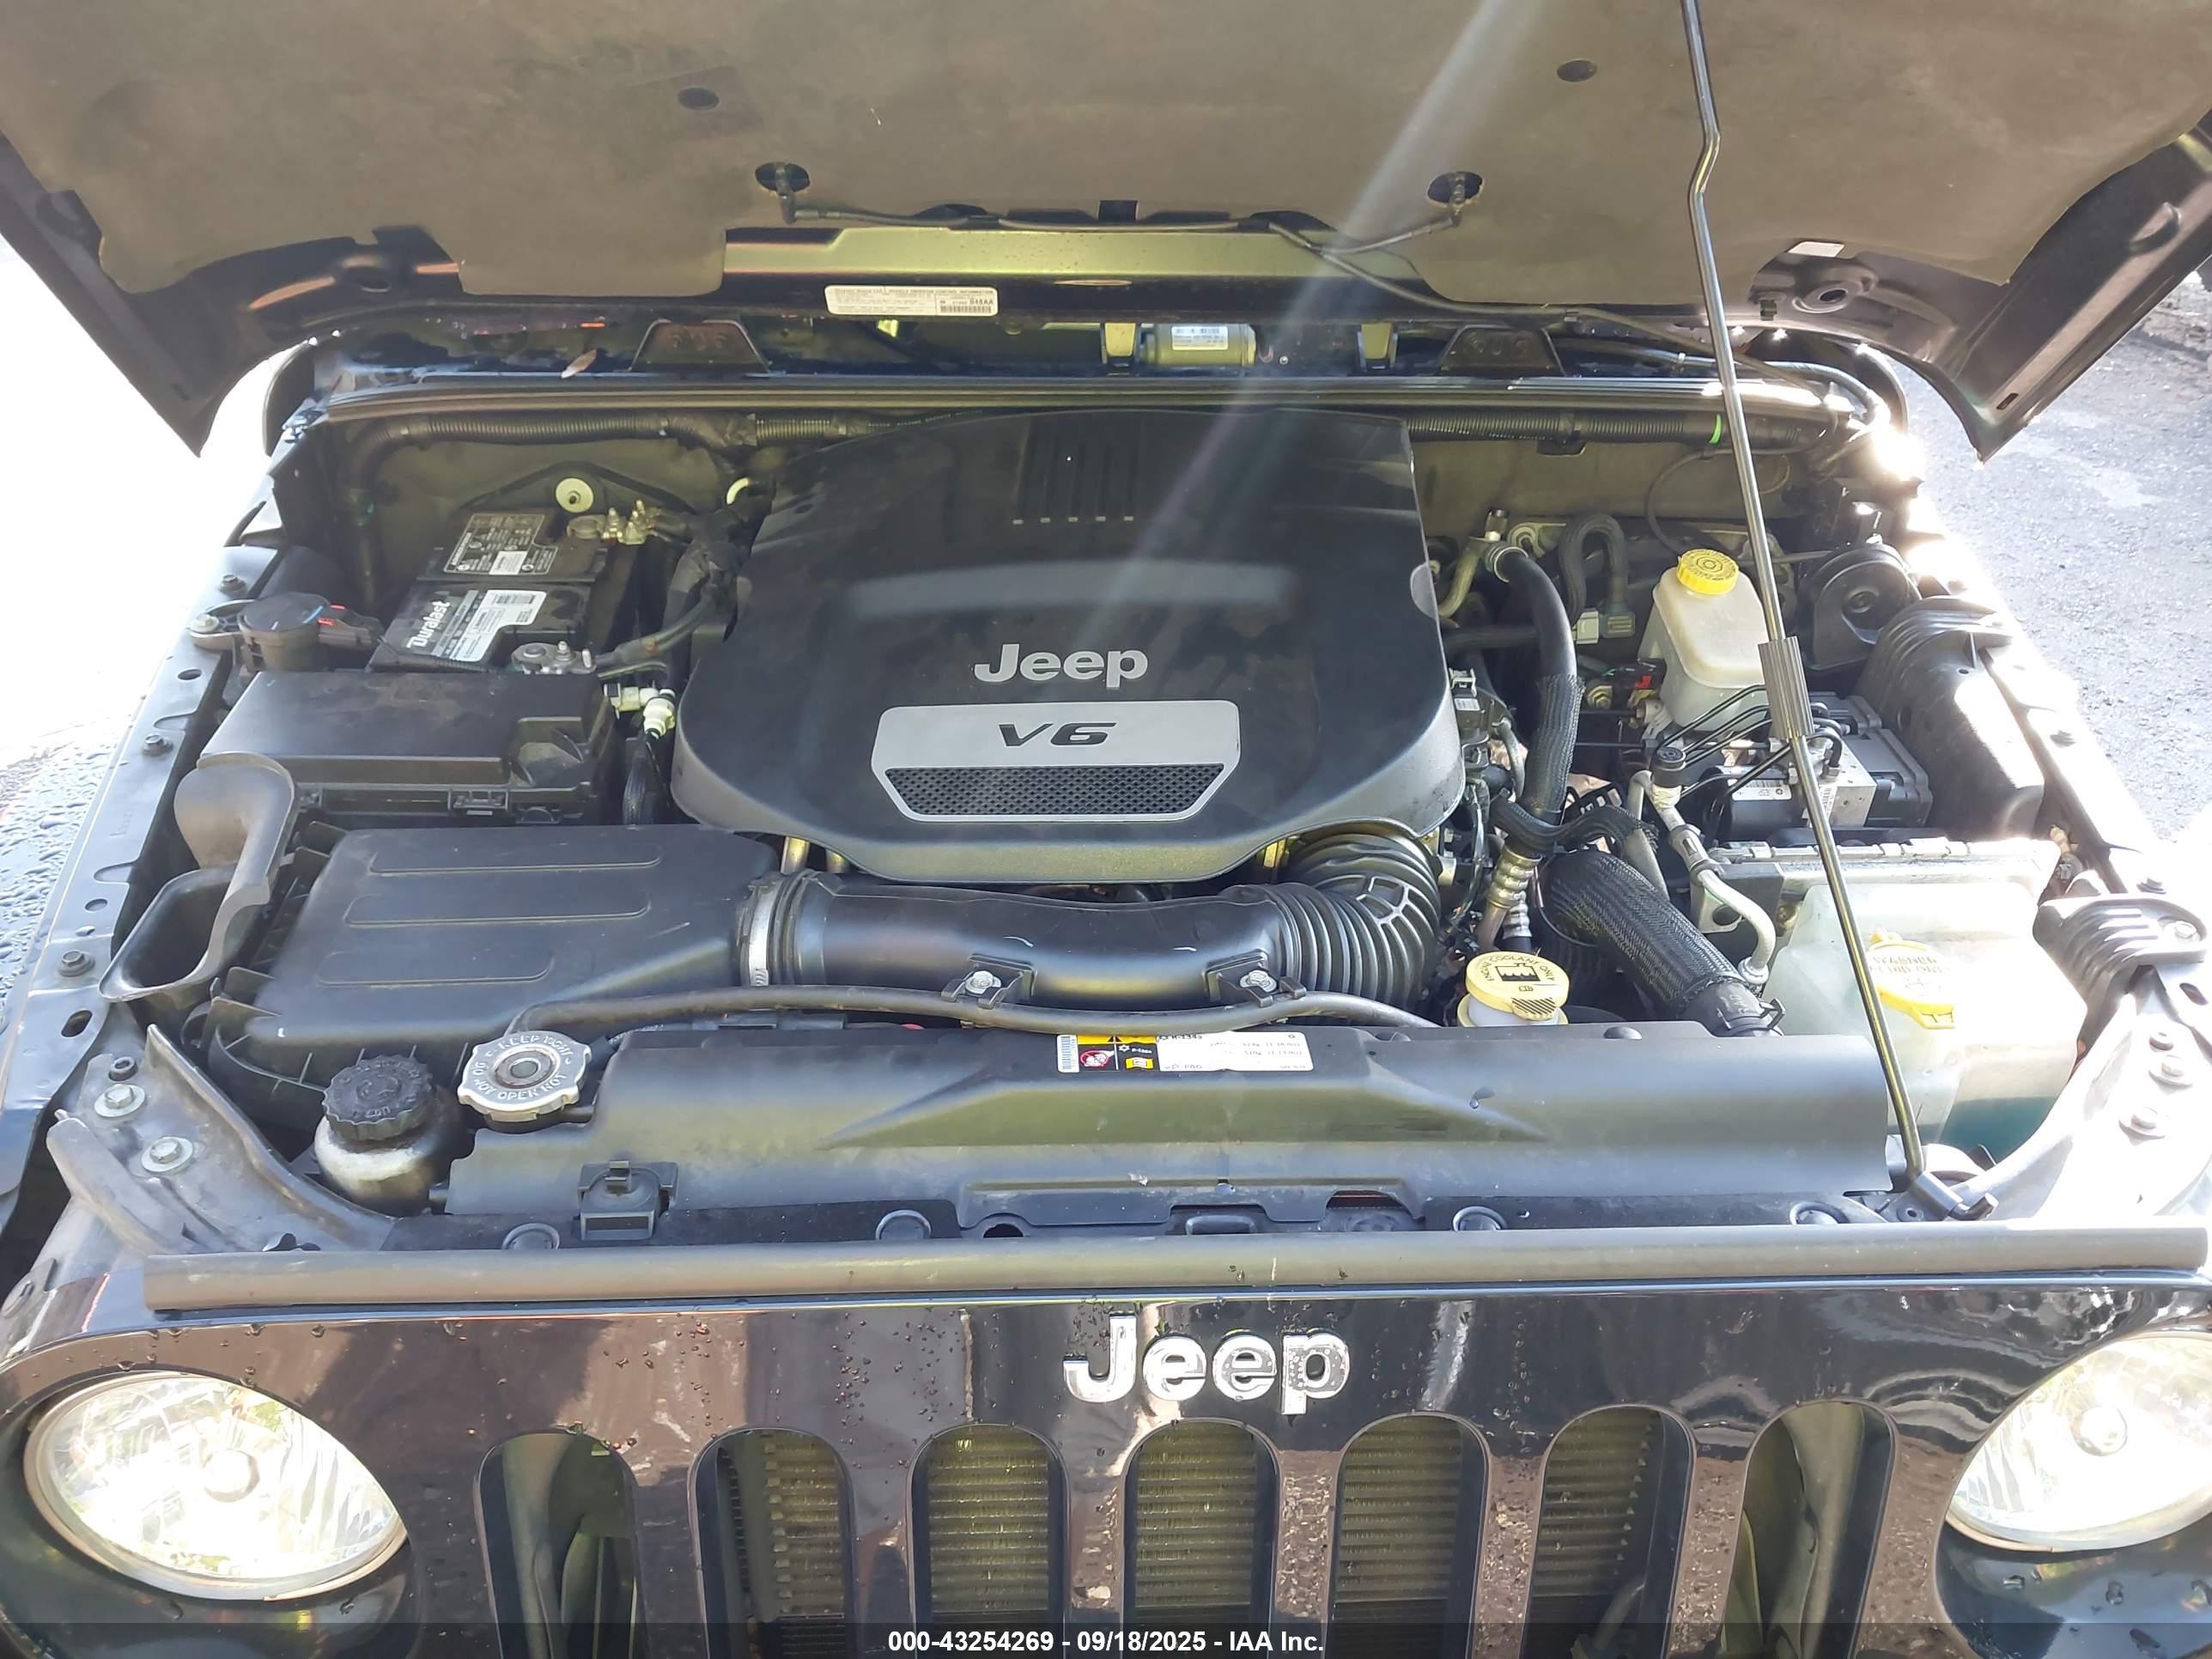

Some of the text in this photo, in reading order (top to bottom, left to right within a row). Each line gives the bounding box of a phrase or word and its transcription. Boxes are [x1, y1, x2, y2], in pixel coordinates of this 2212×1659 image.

[405, 600, 451, 649] Duralast
[973, 643, 1149, 688] Jeep
[999, 722, 1116, 747] V6
[497, 1091, 541, 1101] OPEN
[1063, 1315, 1350, 1415] Jeep
